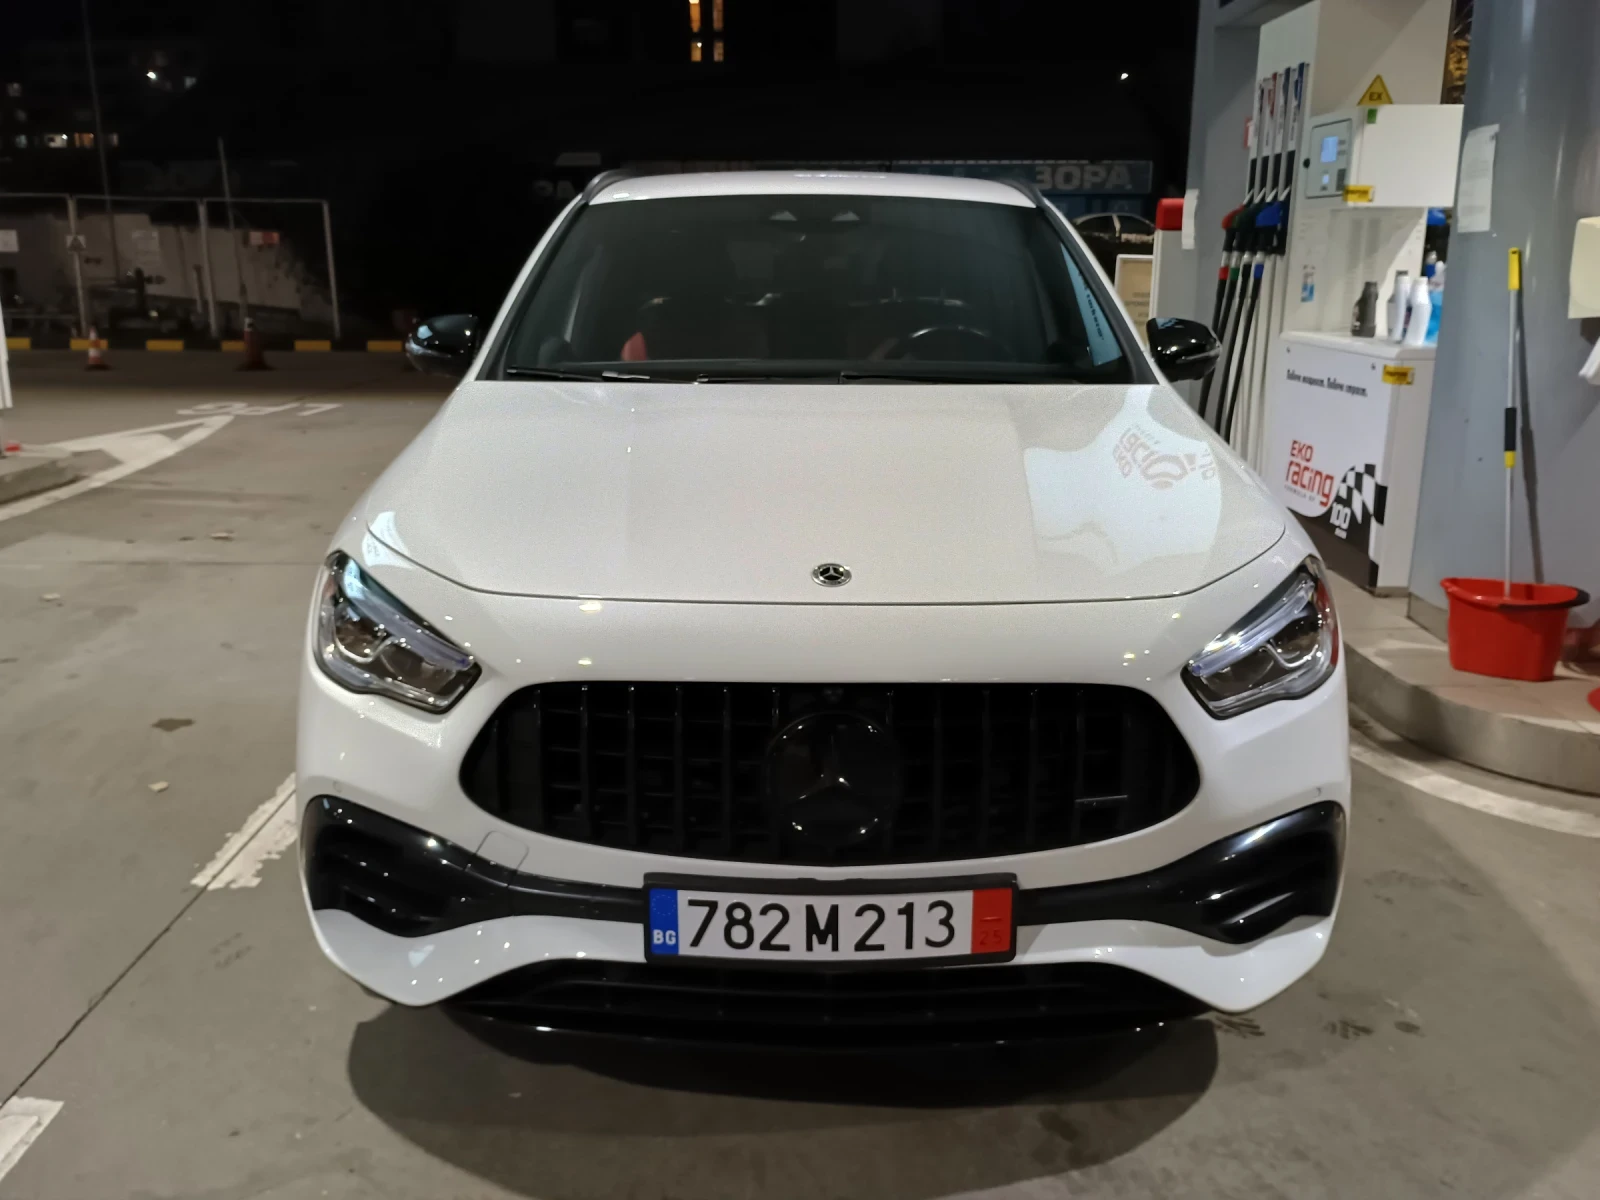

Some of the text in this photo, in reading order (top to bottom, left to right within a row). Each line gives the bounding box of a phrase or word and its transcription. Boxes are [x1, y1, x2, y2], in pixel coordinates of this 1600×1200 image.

[1369, 92, 1382, 101] EX
[1290, 440, 1313, 462] EKO
[1286, 460, 1334, 508] racing
[1330, 502, 1351, 530] 100
[653, 929, 676, 946] BG
